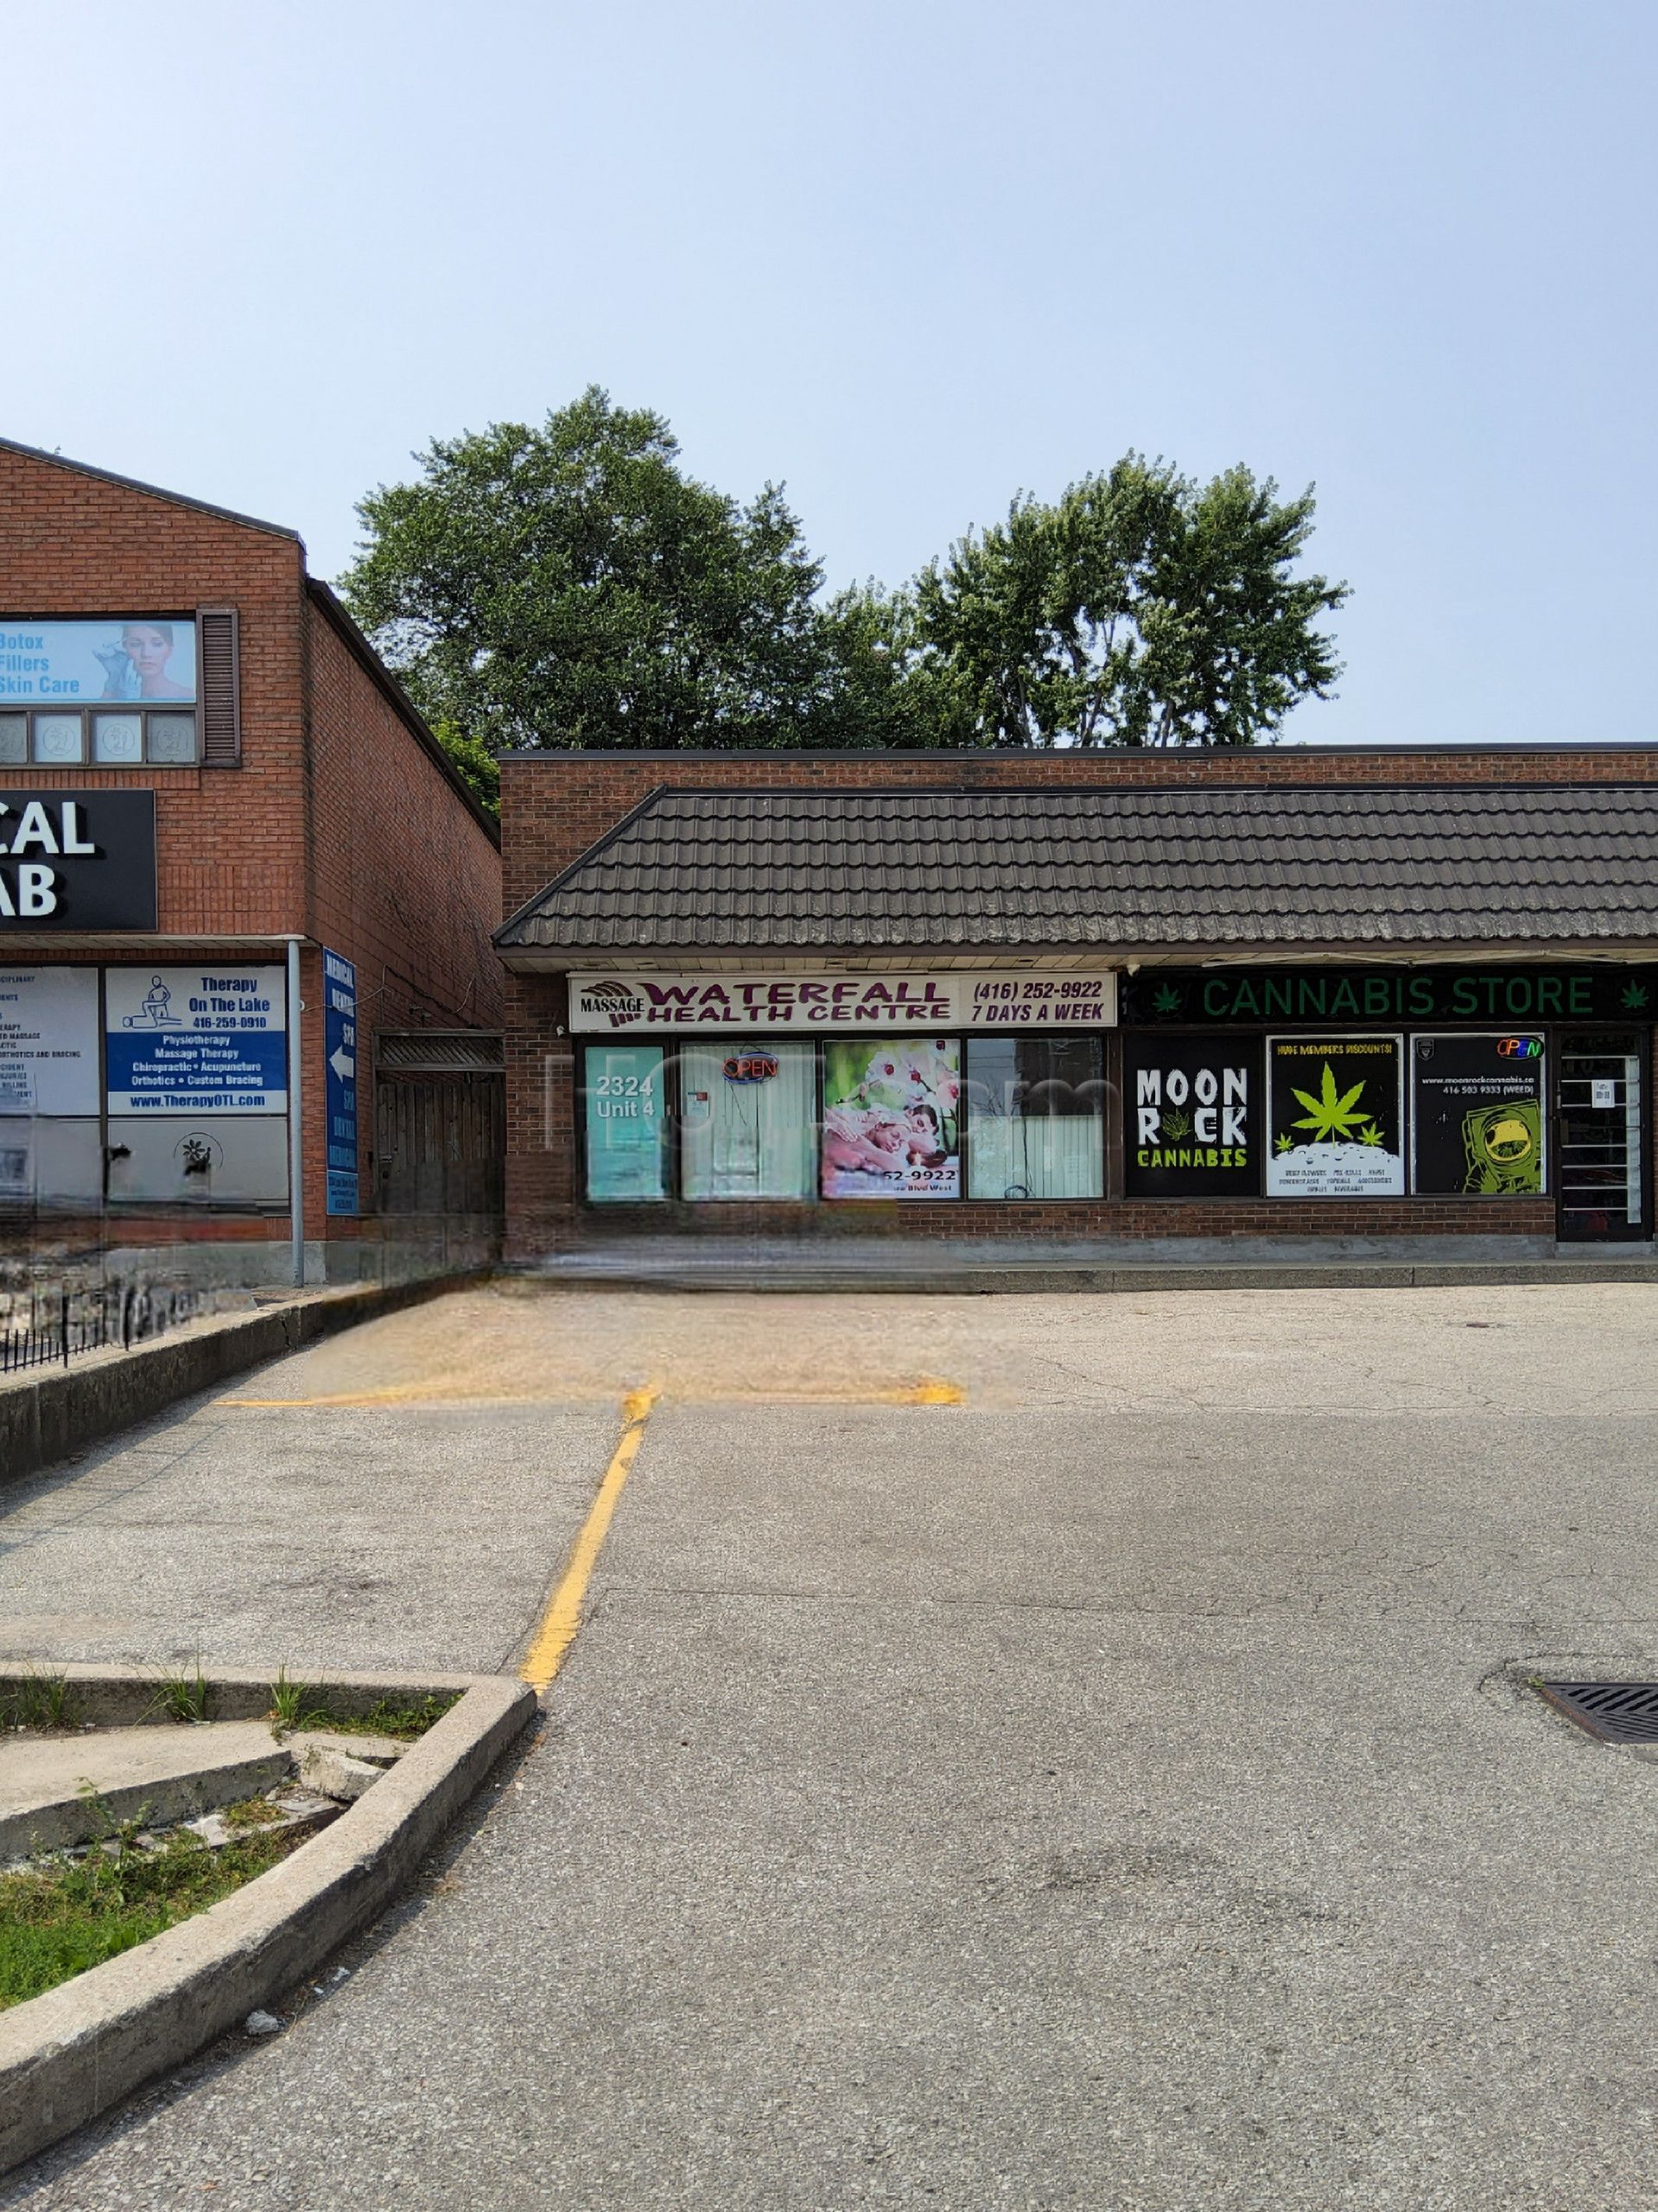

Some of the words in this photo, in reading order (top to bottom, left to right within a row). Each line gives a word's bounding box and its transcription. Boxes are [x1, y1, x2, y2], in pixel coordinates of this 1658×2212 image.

[40, 676, 79, 693] Care
[0, 802, 95, 854] AL
[200, 977, 257, 993] Therapy
[974, 982, 1019, 1002] (416)
[1022, 981, 1102, 1000] 252-9922
[636, 982, 950, 1006] WATERFALL
[1204, 977, 1434, 1016] CANNABIS
[1453, 976, 1594, 1015] STORE
[189, 998, 207, 1012] On
[210, 997, 235, 1012] The
[239, 997, 270, 1012] Lake
[581, 998, 645, 1013] MASSAGE
[647, 1005, 792, 1022] HEALTH
[807, 1003, 951, 1020] CENTRE
[971, 1005, 981, 1021] 7
[986, 1004, 1032, 1021] DAYS
[1036, 1004, 1048, 1020] A
[1054, 1002, 1104, 1020] WEEK
[193, 1016, 267, 1028] 416-259-0910
[163, 1035, 231, 1046] Physiotherapy
[1497, 1039, 1541, 1057] OPEN
[155, 1049, 198, 1059] Massage
[200, 1049, 239, 1059] Therapy
[132, 1062, 192, 1072] Chiropractic
[200, 1062, 262, 1072] Acupuncture
[722, 1058, 778, 1077] OPEN
[131, 1076, 175, 1086] Orthotics
[187, 1075, 223, 1085] Custom
[226, 1075, 264, 1086] Bracing
[595, 1076, 653, 1096] 2324
[1137, 1068, 1248, 1106] MOON
[1503, 1085, 1534, 1096] (WEED)
[130, 1094, 265, 1108] www.TherapyOTL.com
[596, 1101, 638, 1118] Unit
[642, 1101, 655, 1117] 4
[1137, 1107, 1248, 1145] RCK
[1137, 1148, 1248, 1167] CANNABIS
